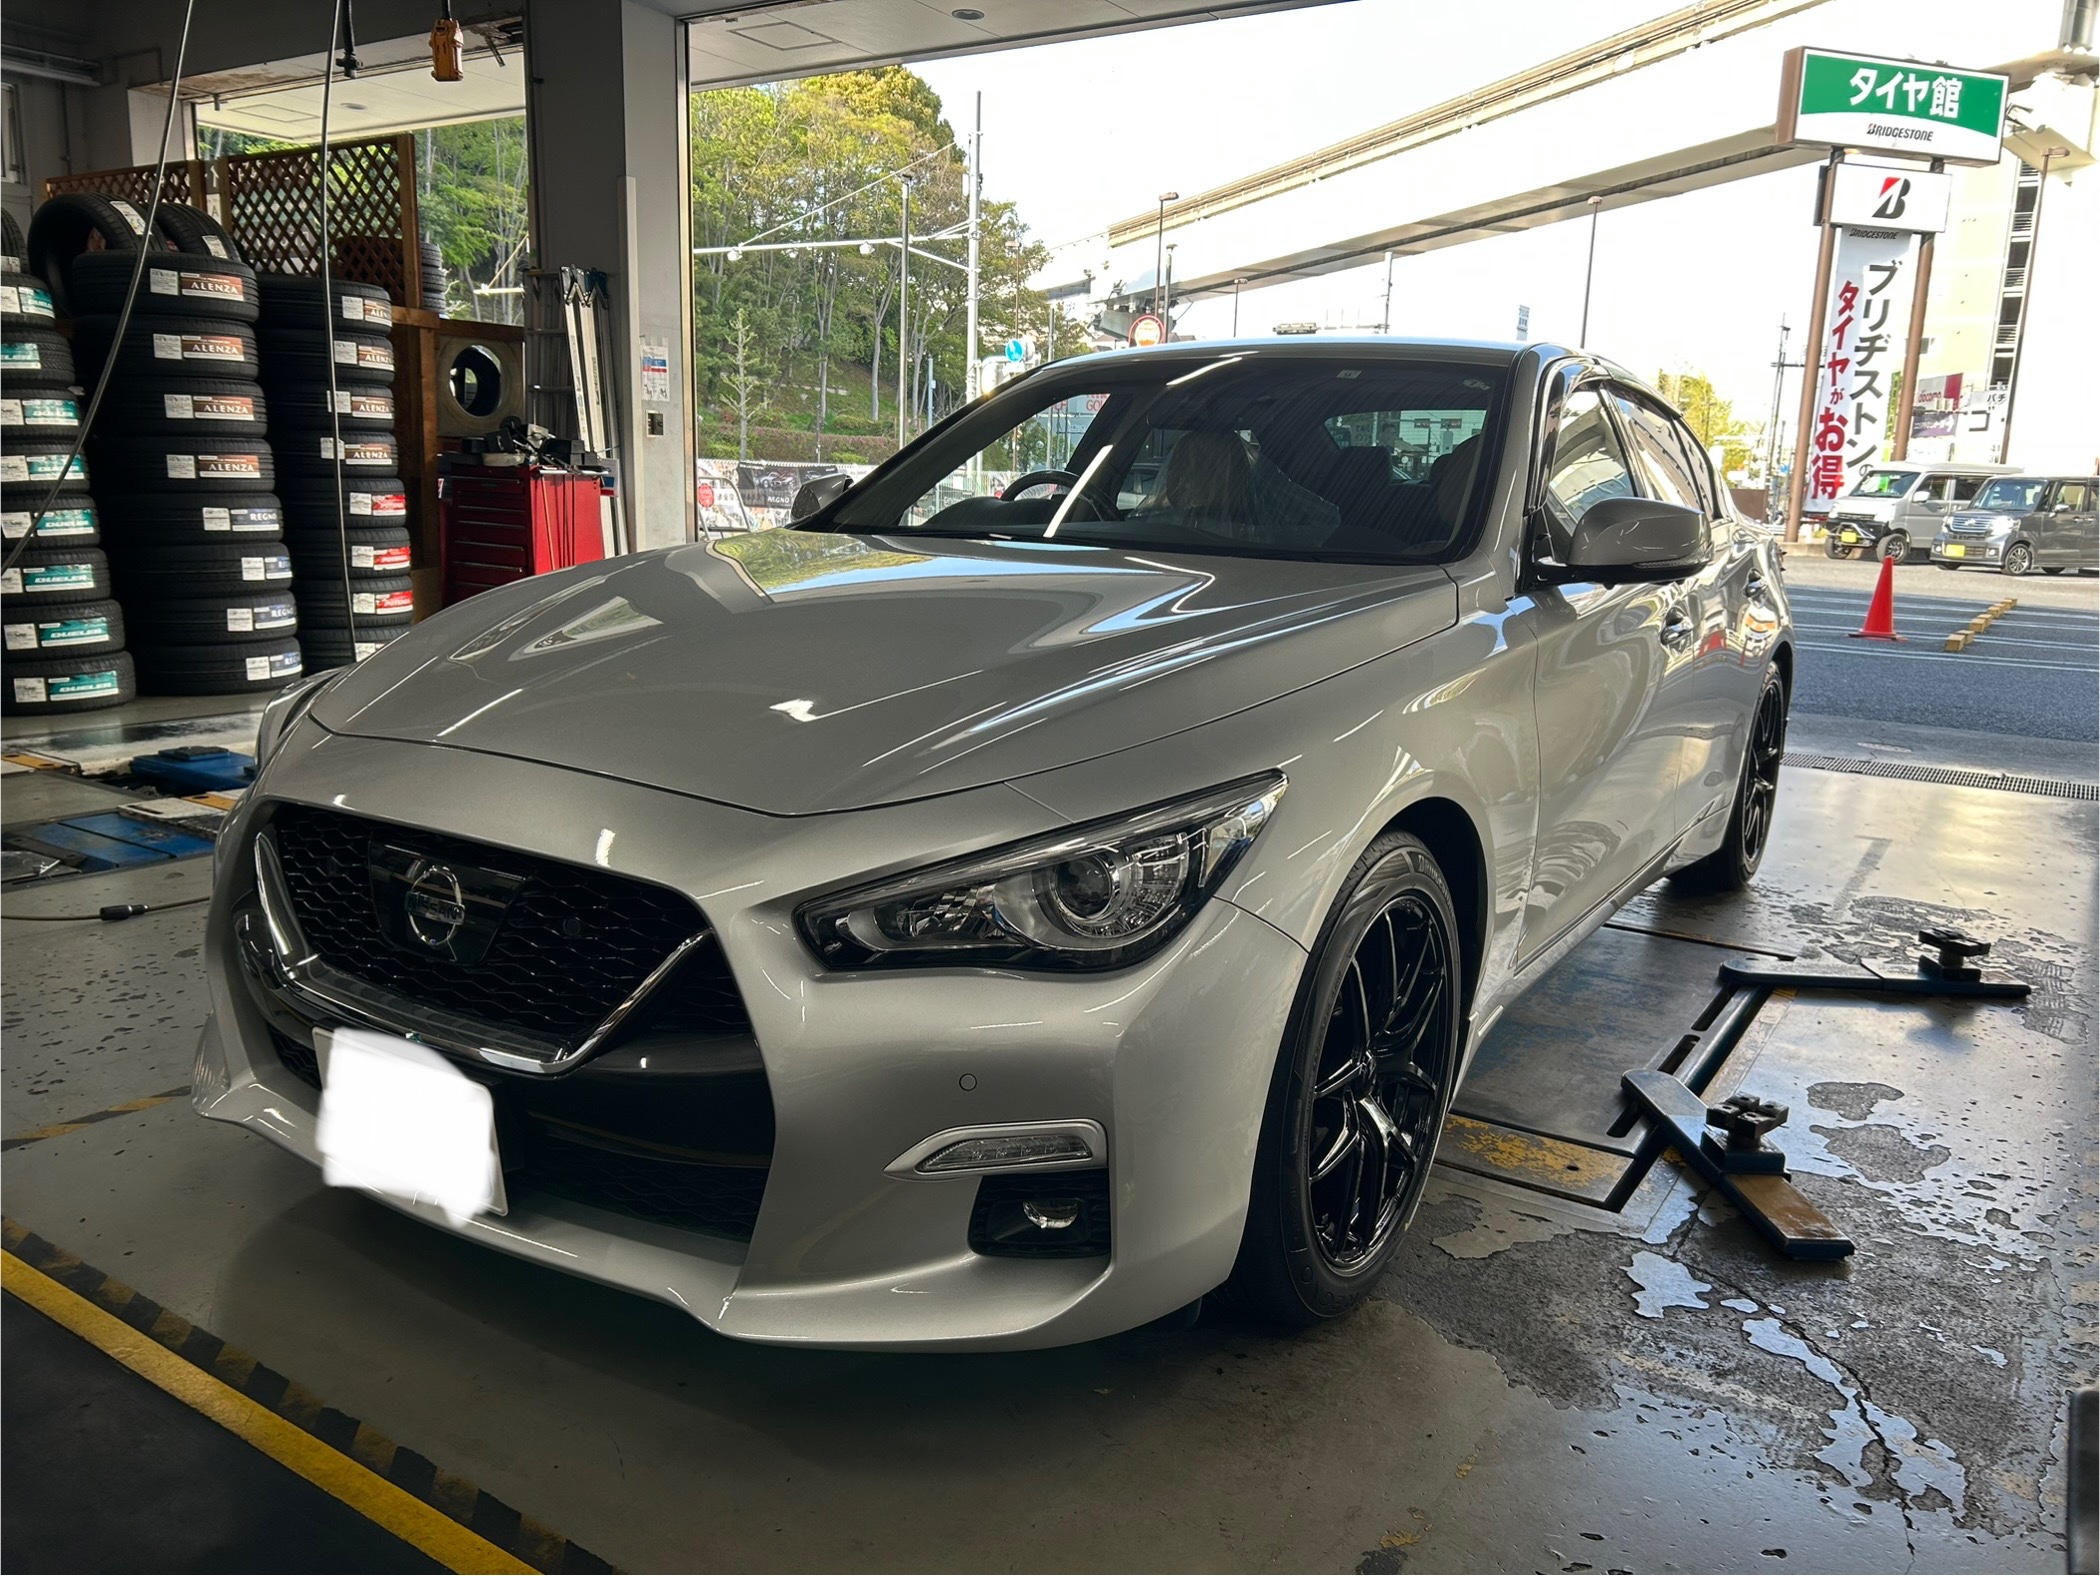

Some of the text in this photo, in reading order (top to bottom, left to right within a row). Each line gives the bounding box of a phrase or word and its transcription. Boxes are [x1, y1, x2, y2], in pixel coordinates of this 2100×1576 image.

[1849, 67, 1963, 119] タイヤ館
[1866, 123, 1934, 142] BRIDGESTONE
[1848, 228, 1899, 240] BRIDGESTONE
[190, 281, 239, 294] ALENZA
[191, 344, 240, 355] ALENZA
[1811, 280, 1860, 500] タイヤがお得
[203, 404, 250, 414] ALENZA
[359, 404, 390, 412] ALENZA
[353, 451, 389, 459] ALENZA
[208, 463, 255, 472] ALENZA
[35, 574, 88, 584] DUELER
[50, 627, 103, 639] DUELER
[59, 682, 113, 693] DUELER
